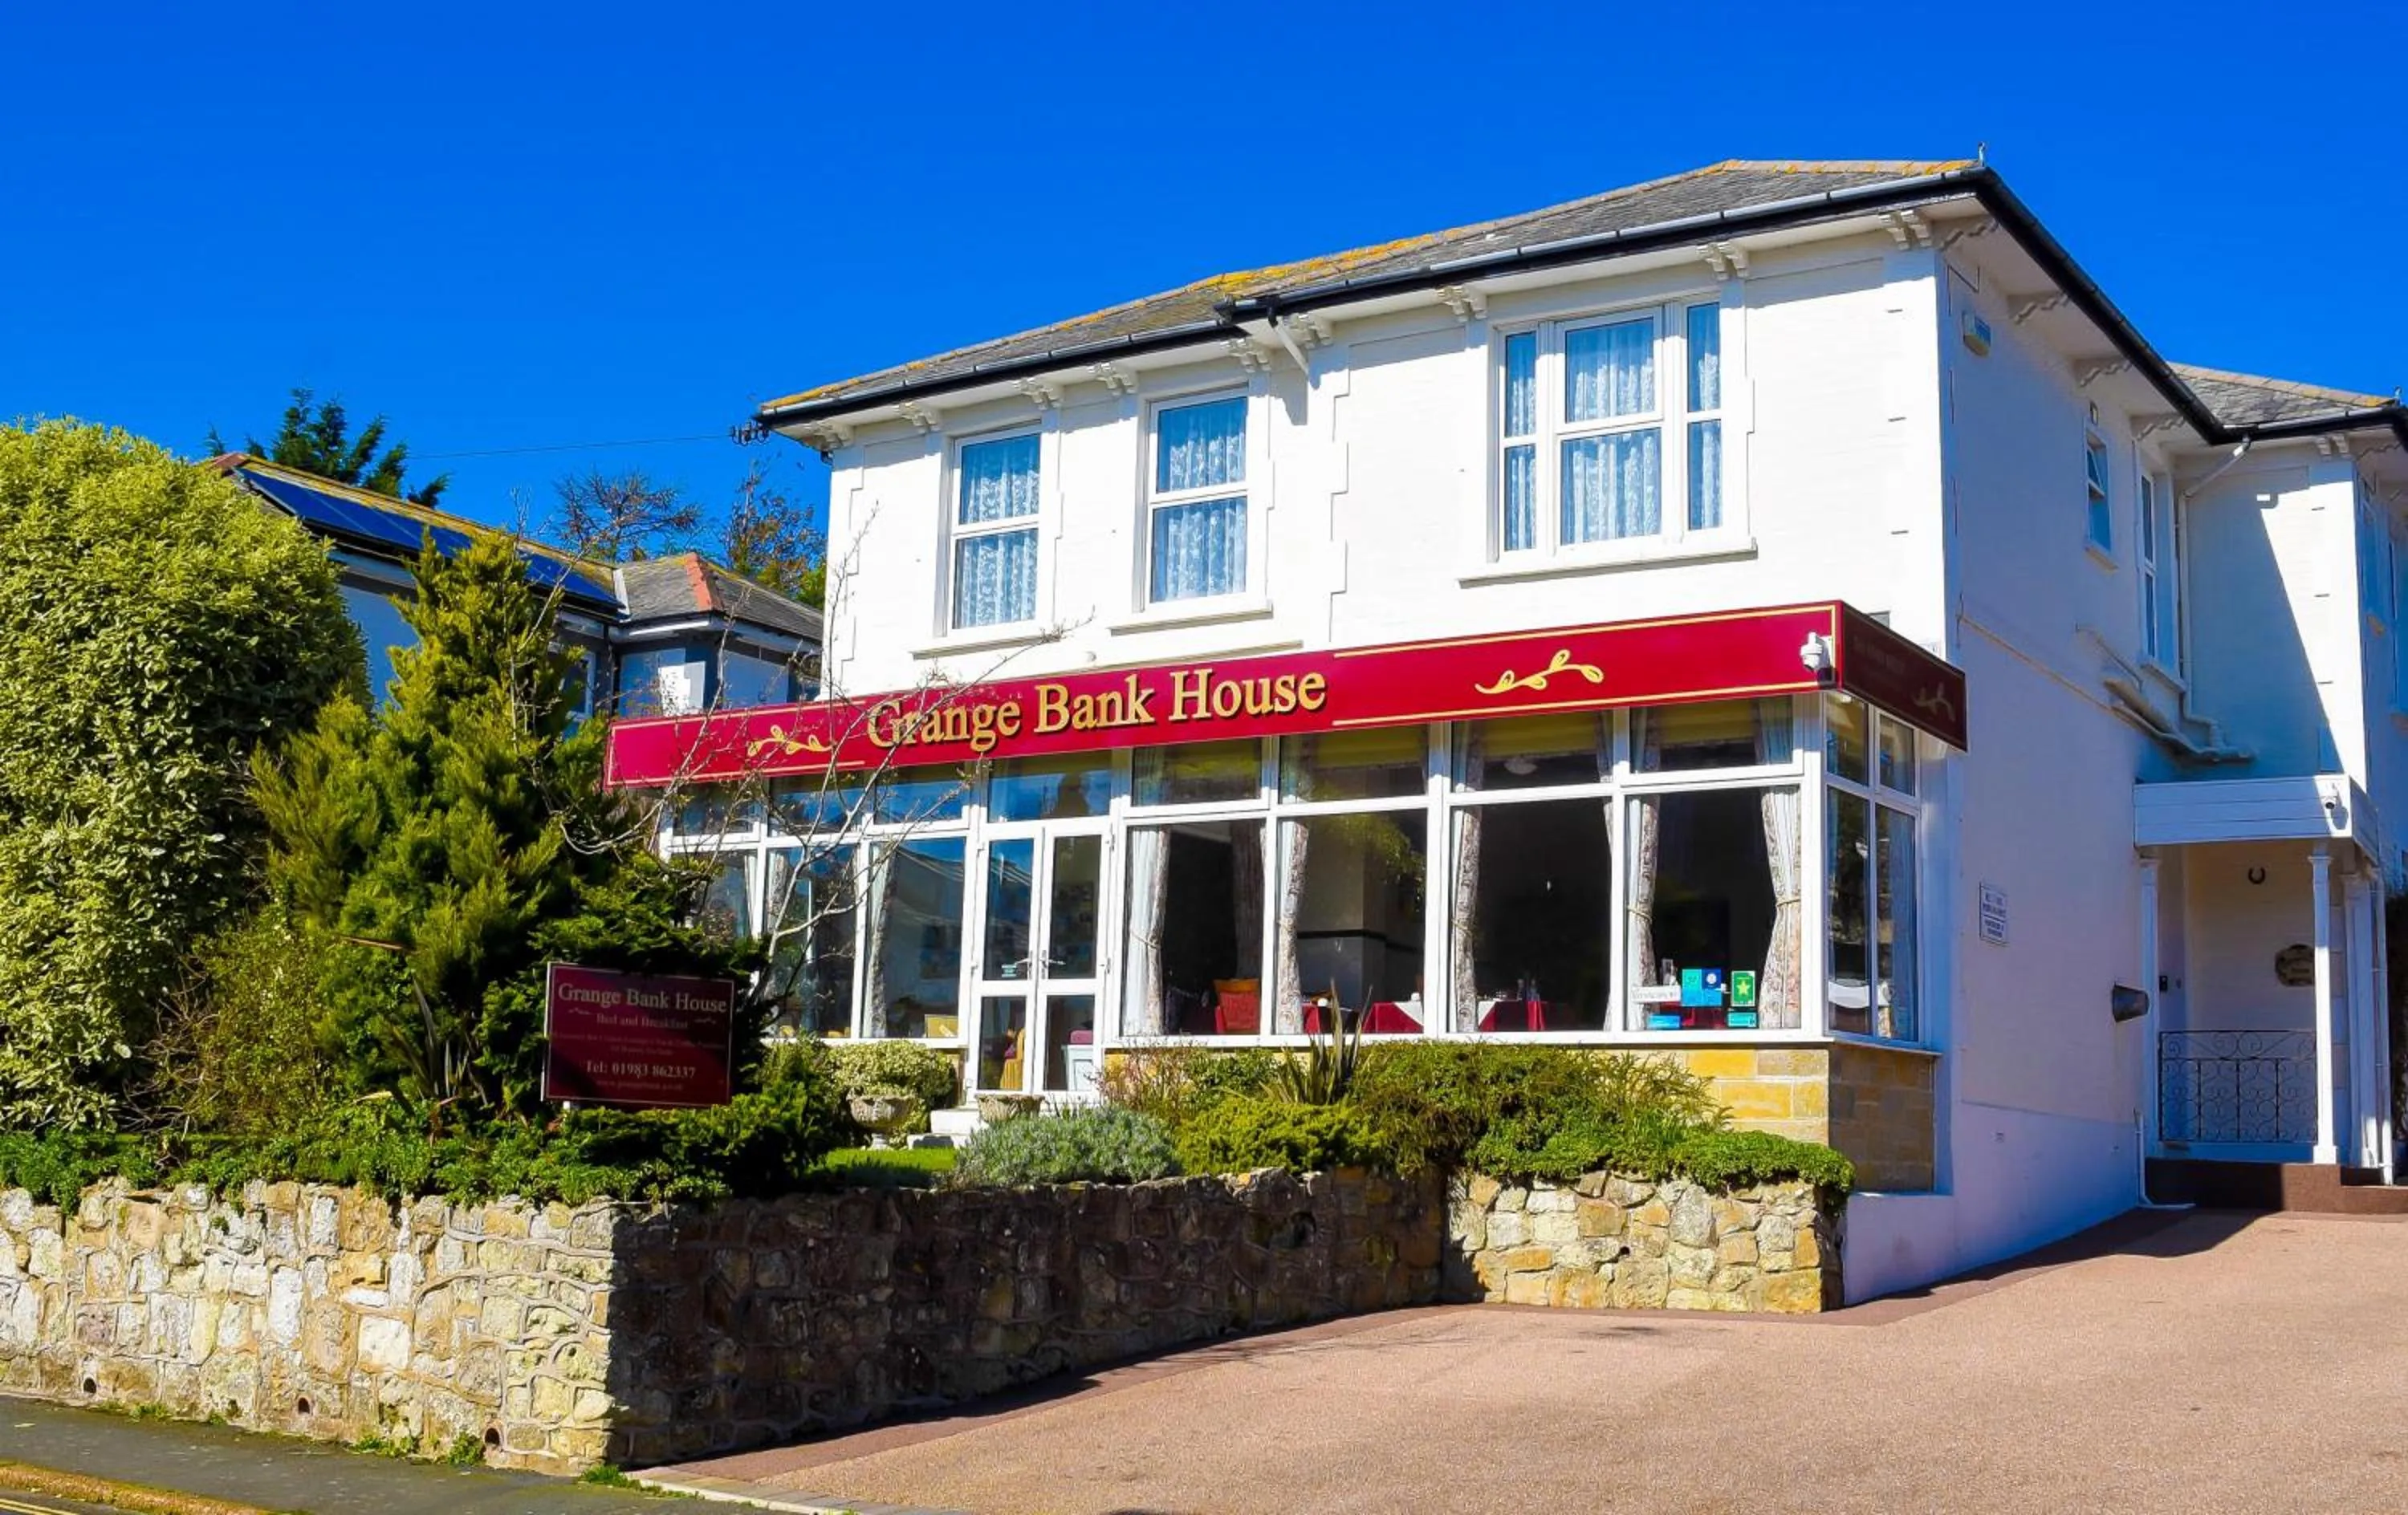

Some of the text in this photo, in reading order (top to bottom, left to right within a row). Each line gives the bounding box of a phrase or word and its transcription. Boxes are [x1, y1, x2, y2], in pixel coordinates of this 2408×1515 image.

[867, 668, 1326, 752] Grange Bank House
[558, 983, 727, 1013] Grange Bank House
[620, 1015, 638, 1026] and
[585, 1060, 608, 1073] Tel:
[612, 1062, 648, 1077] 01983
